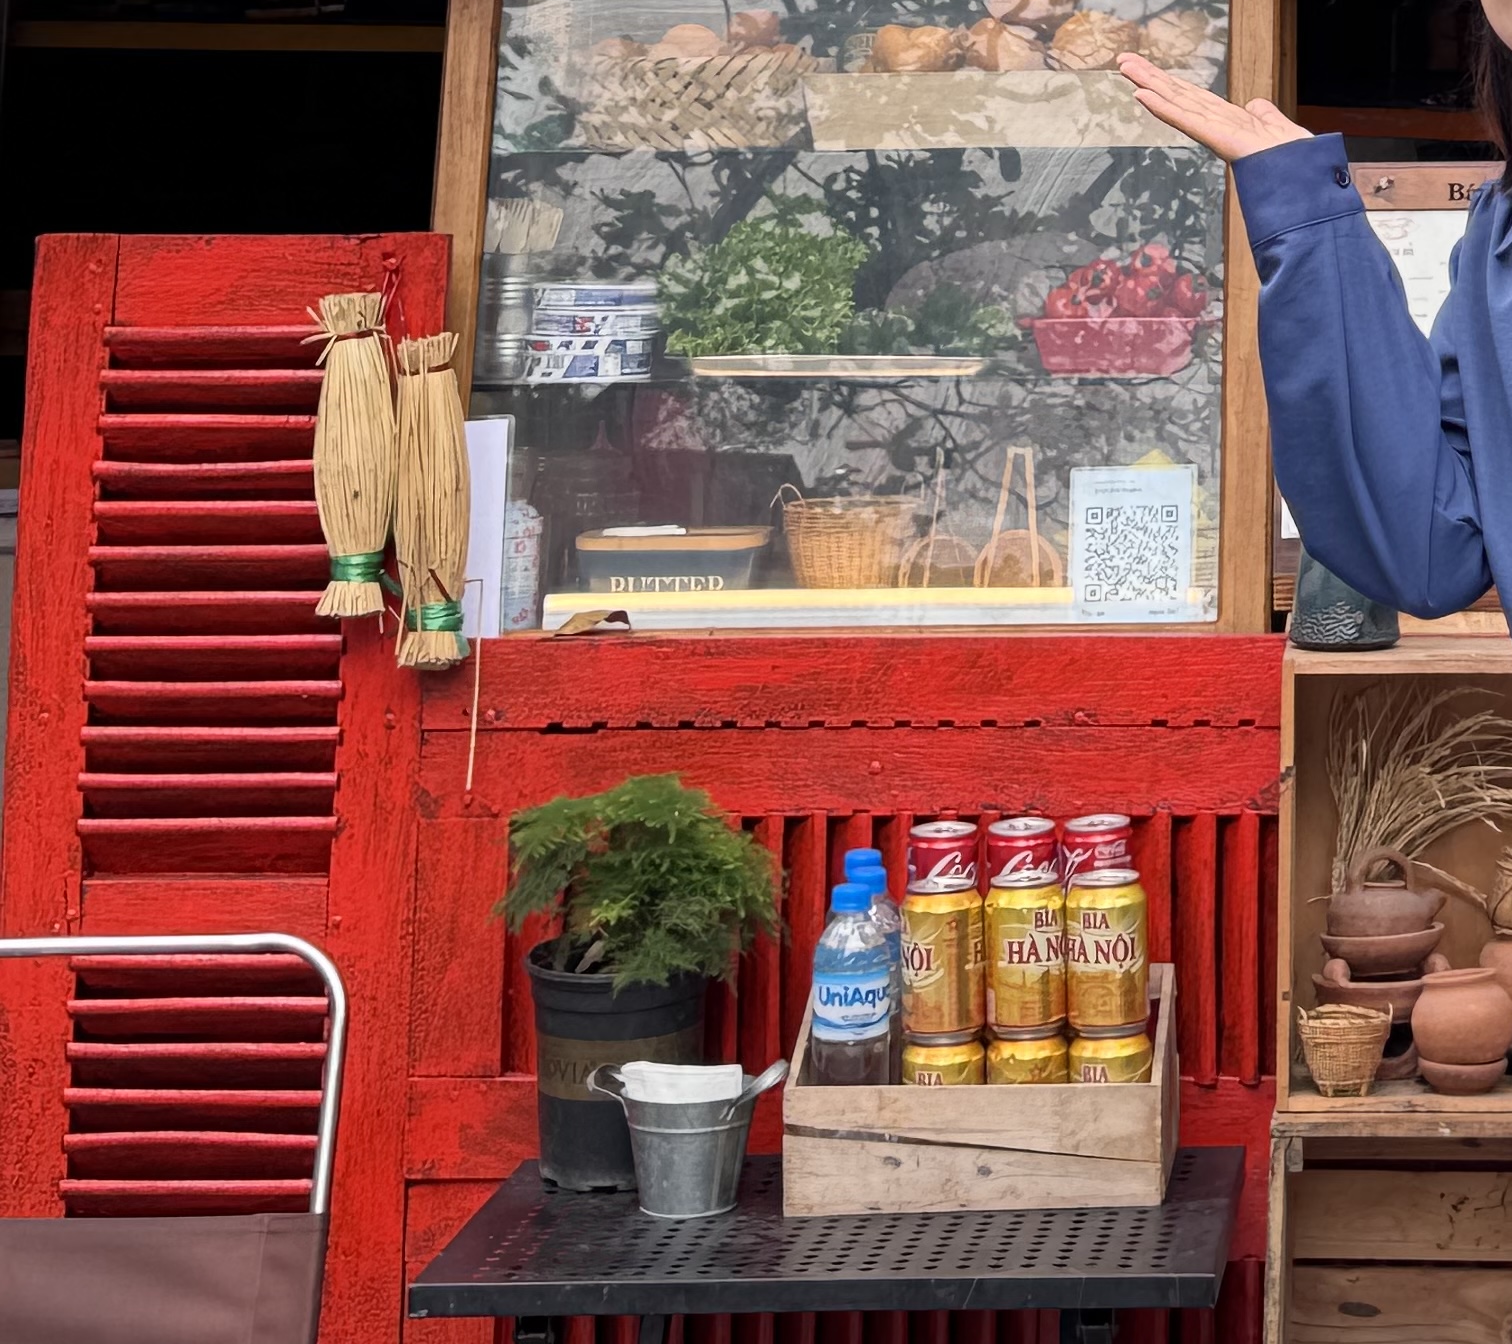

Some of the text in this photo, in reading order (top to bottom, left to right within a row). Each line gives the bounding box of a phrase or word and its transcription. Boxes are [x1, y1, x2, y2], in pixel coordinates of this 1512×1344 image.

[1083, 911, 1110, 930] BIA
[1007, 933, 1043, 965] HÀ
[1094, 933, 1137, 969] NỘI
